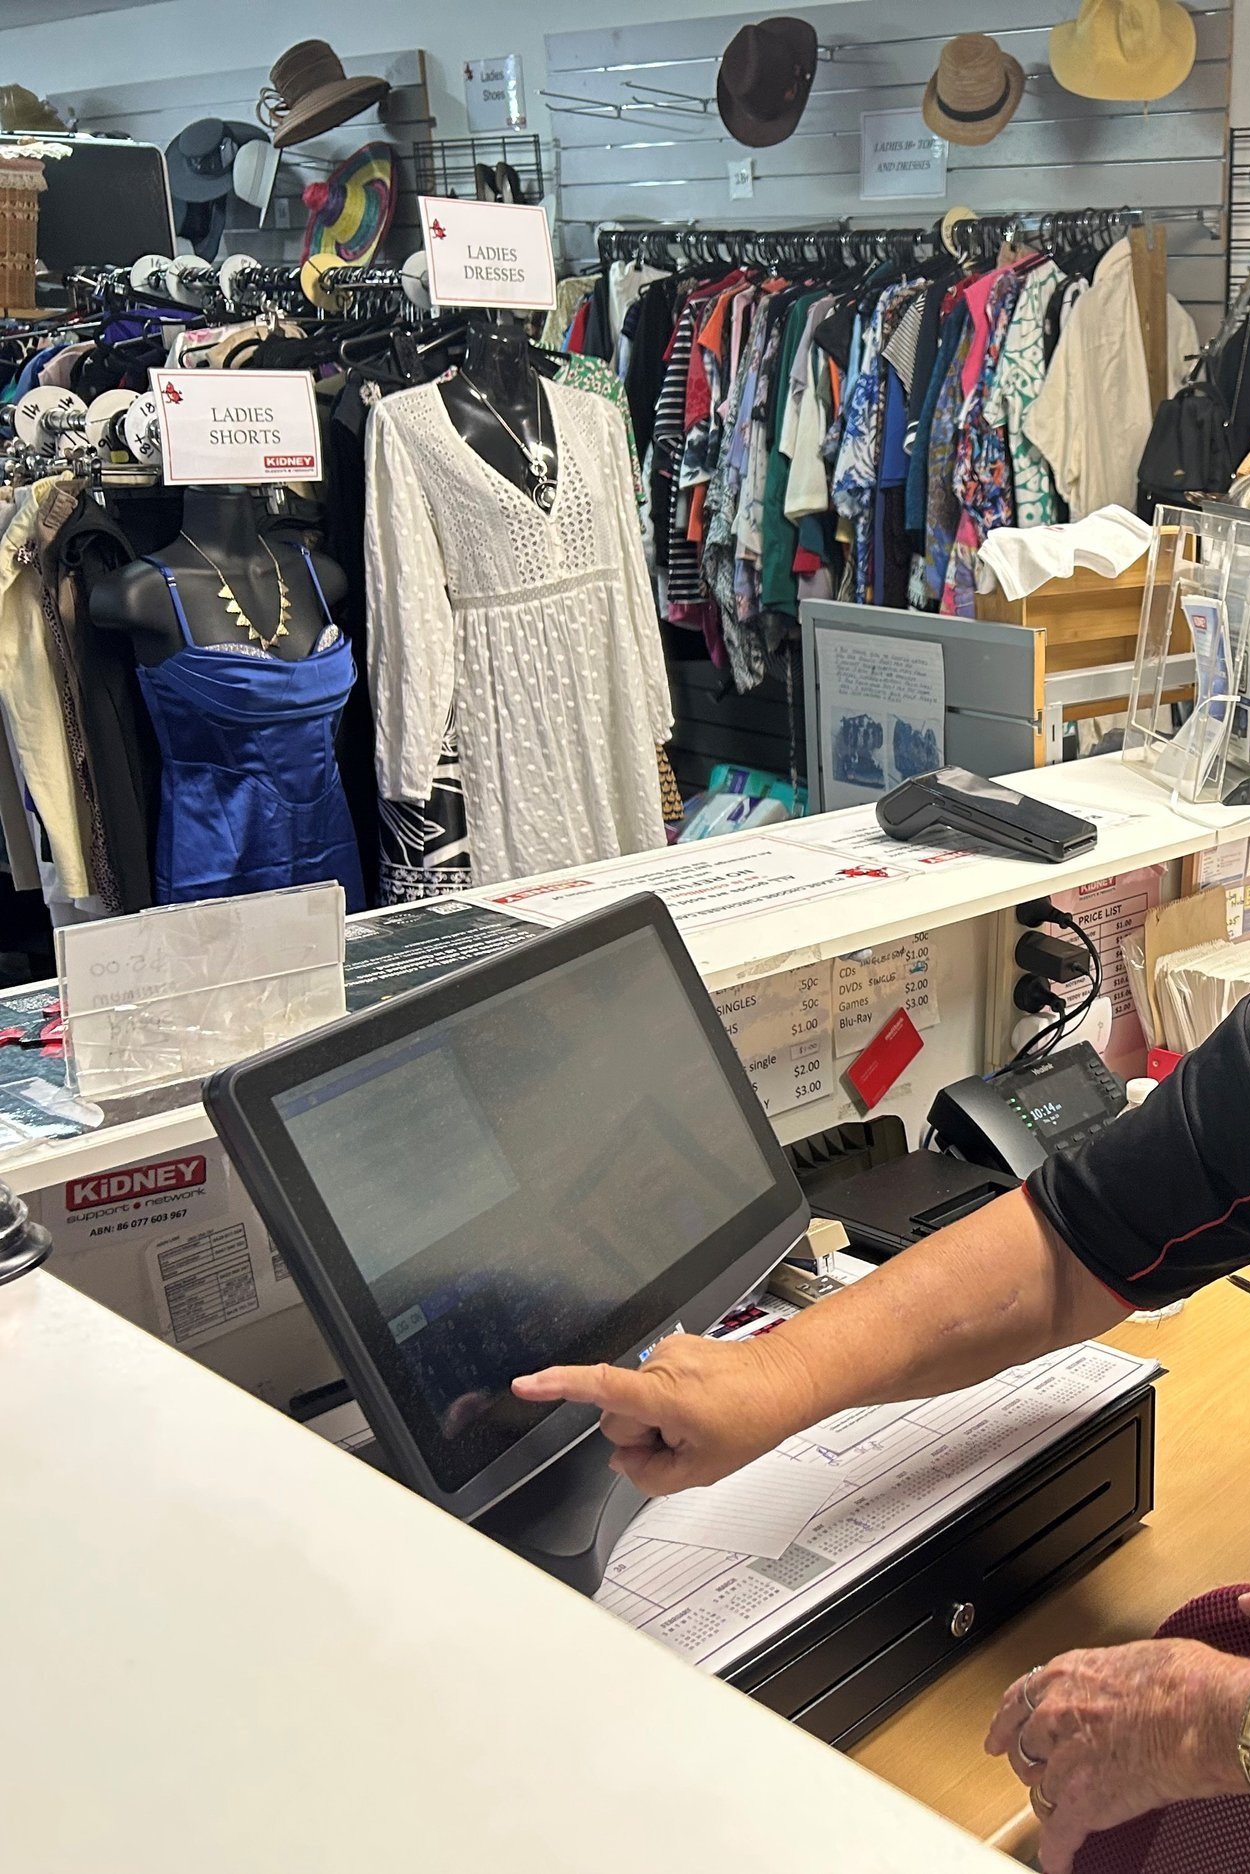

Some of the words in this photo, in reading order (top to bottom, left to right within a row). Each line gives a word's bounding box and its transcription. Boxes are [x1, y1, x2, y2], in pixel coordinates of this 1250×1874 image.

[877, 162, 895, 173] AND
[467, 245, 518, 262] LADIES
[464, 265, 526, 283] DRESSES
[211, 407, 274, 423] LADIES
[210, 429, 281, 445] SHORTS
[721, 869, 756, 877] NO
[647, 875, 729, 894] REFUND
[1078, 910, 1103, 926] PRICE
[1105, 904, 1122, 917] LIST
[1116, 918, 1132, 930] $1.00
[839, 966, 856, 979] CDs
[905, 946, 929, 962] $1.00
[838, 997, 869, 1012] Games
[905, 978, 929, 994] $2.00
[839, 981, 863, 996] DVDs
[716, 995, 757, 1016] SINGLES
[800, 997, 820, 1012] .50c
[839, 1012, 873, 1029] Blu-Ray
[905, 994, 929, 1010] $3.00
[791, 1018, 818, 1037] $1.00
[749, 1054, 777, 1073] single
[793, 1059, 820, 1078] $2.00
[794, 1080, 822, 1099] $3.00
[1030, 1102, 1056, 1121] 10:14
[73, 1159, 200, 1204] KiDNEY
[66, 1203, 130, 1224] support
[145, 1187, 207, 1207] network
[89, 1225, 116, 1237] ABN:
[117, 1222, 129, 1232] 86
[130, 1217, 149, 1228] 077
[151, 1213, 168, 1224] 603
[169, 1208, 188, 1220] 967
